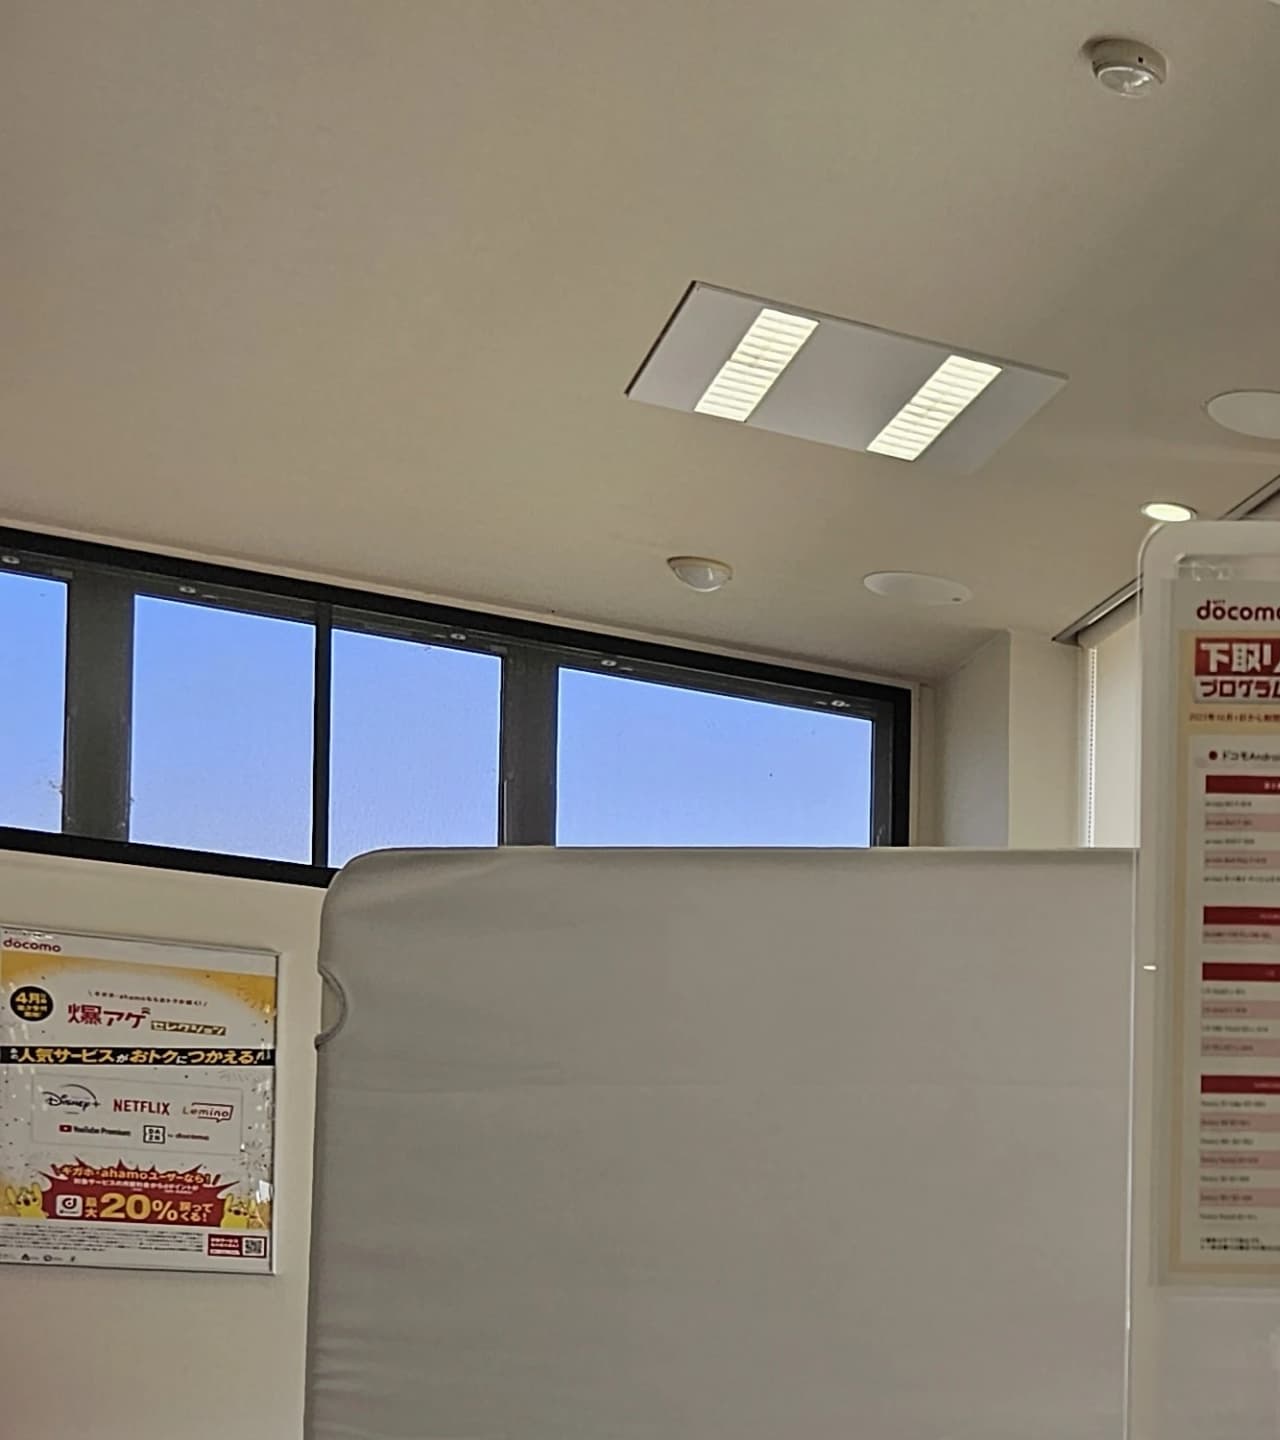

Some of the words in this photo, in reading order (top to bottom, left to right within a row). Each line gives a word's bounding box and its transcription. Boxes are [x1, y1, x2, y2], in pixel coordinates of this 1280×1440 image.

[2, 936, 62, 953] docomo
[67, 1002, 151, 1030] 爆アゲ
[113, 1098, 171, 1116] NETFLIX
[181, 1104, 230, 1119] Lemino
